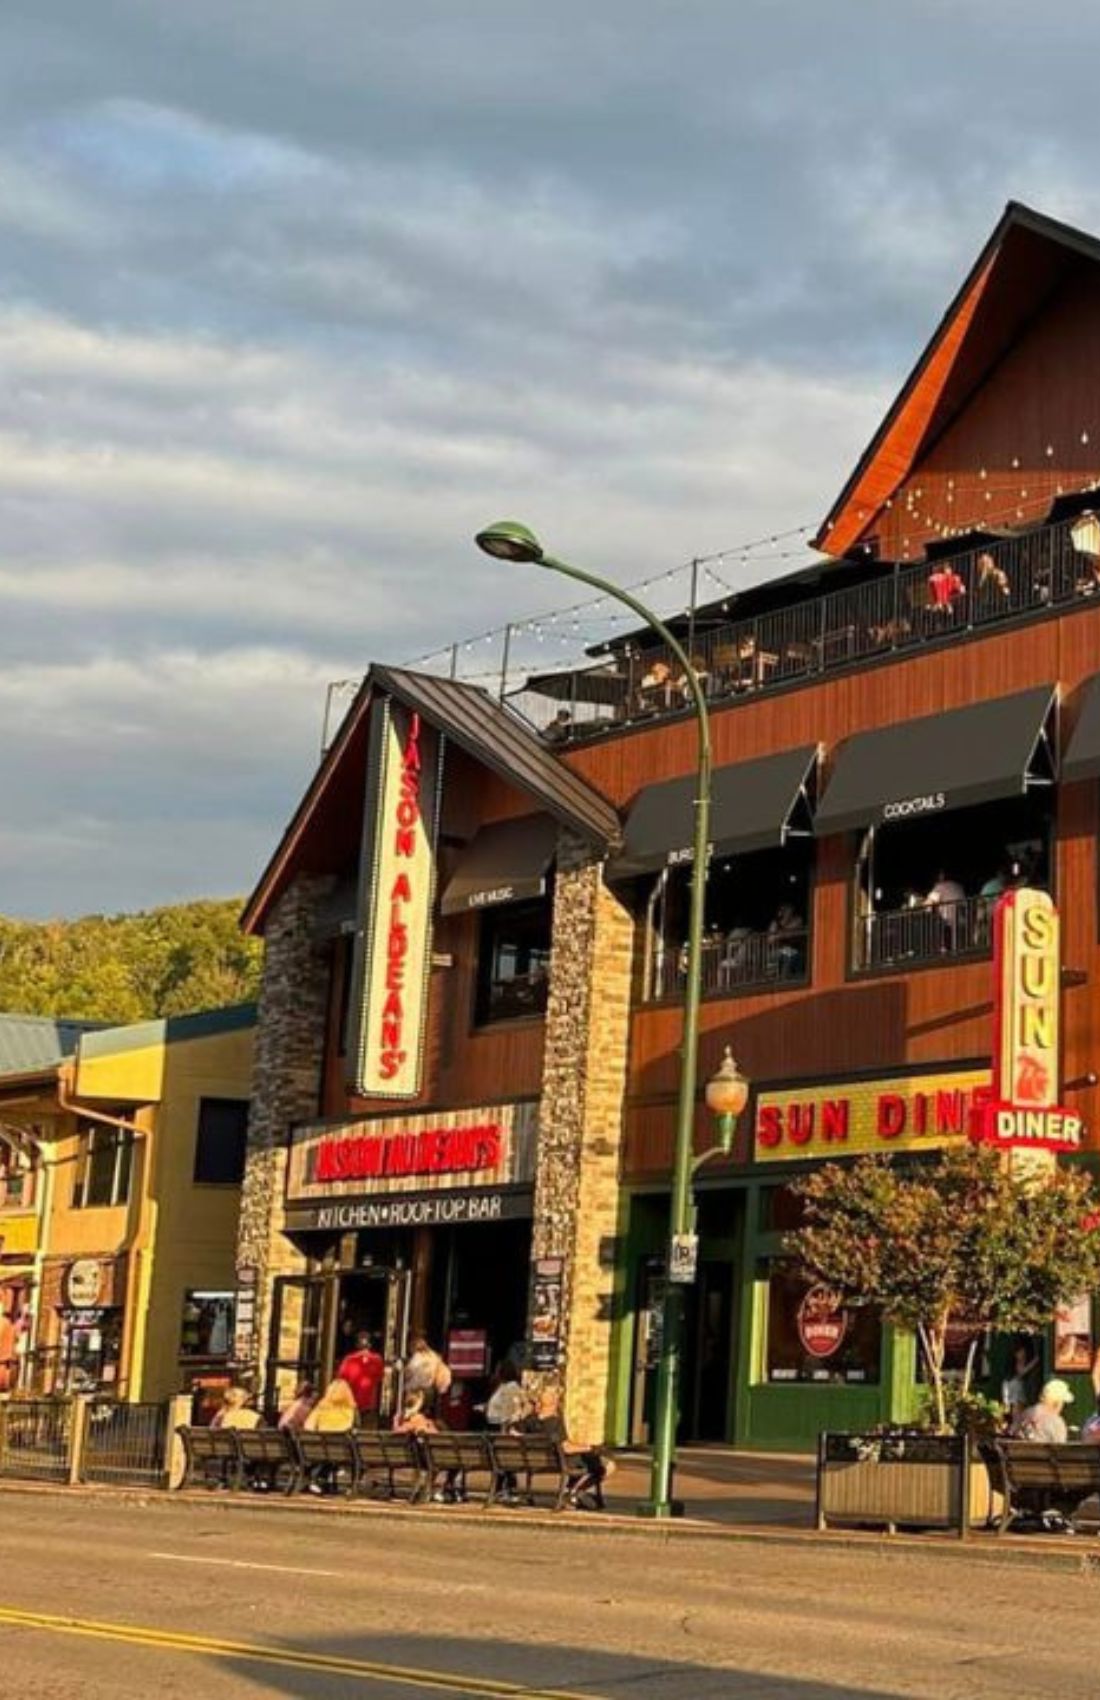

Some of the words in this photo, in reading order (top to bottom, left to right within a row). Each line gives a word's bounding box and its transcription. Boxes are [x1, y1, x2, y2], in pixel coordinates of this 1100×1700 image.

[396, 712, 420, 857] JASON
[884, 793, 945, 818] COCKTAILS
[1021, 906, 1053, 1049] SUN
[758, 1101, 849, 1147] SUN
[998, 1110, 1081, 1145] DINER
[317, 1203, 382, 1227] KITCHEN
[389, 1198, 467, 1222] ROOFTOP
[468, 1196, 501, 1217] BAR
